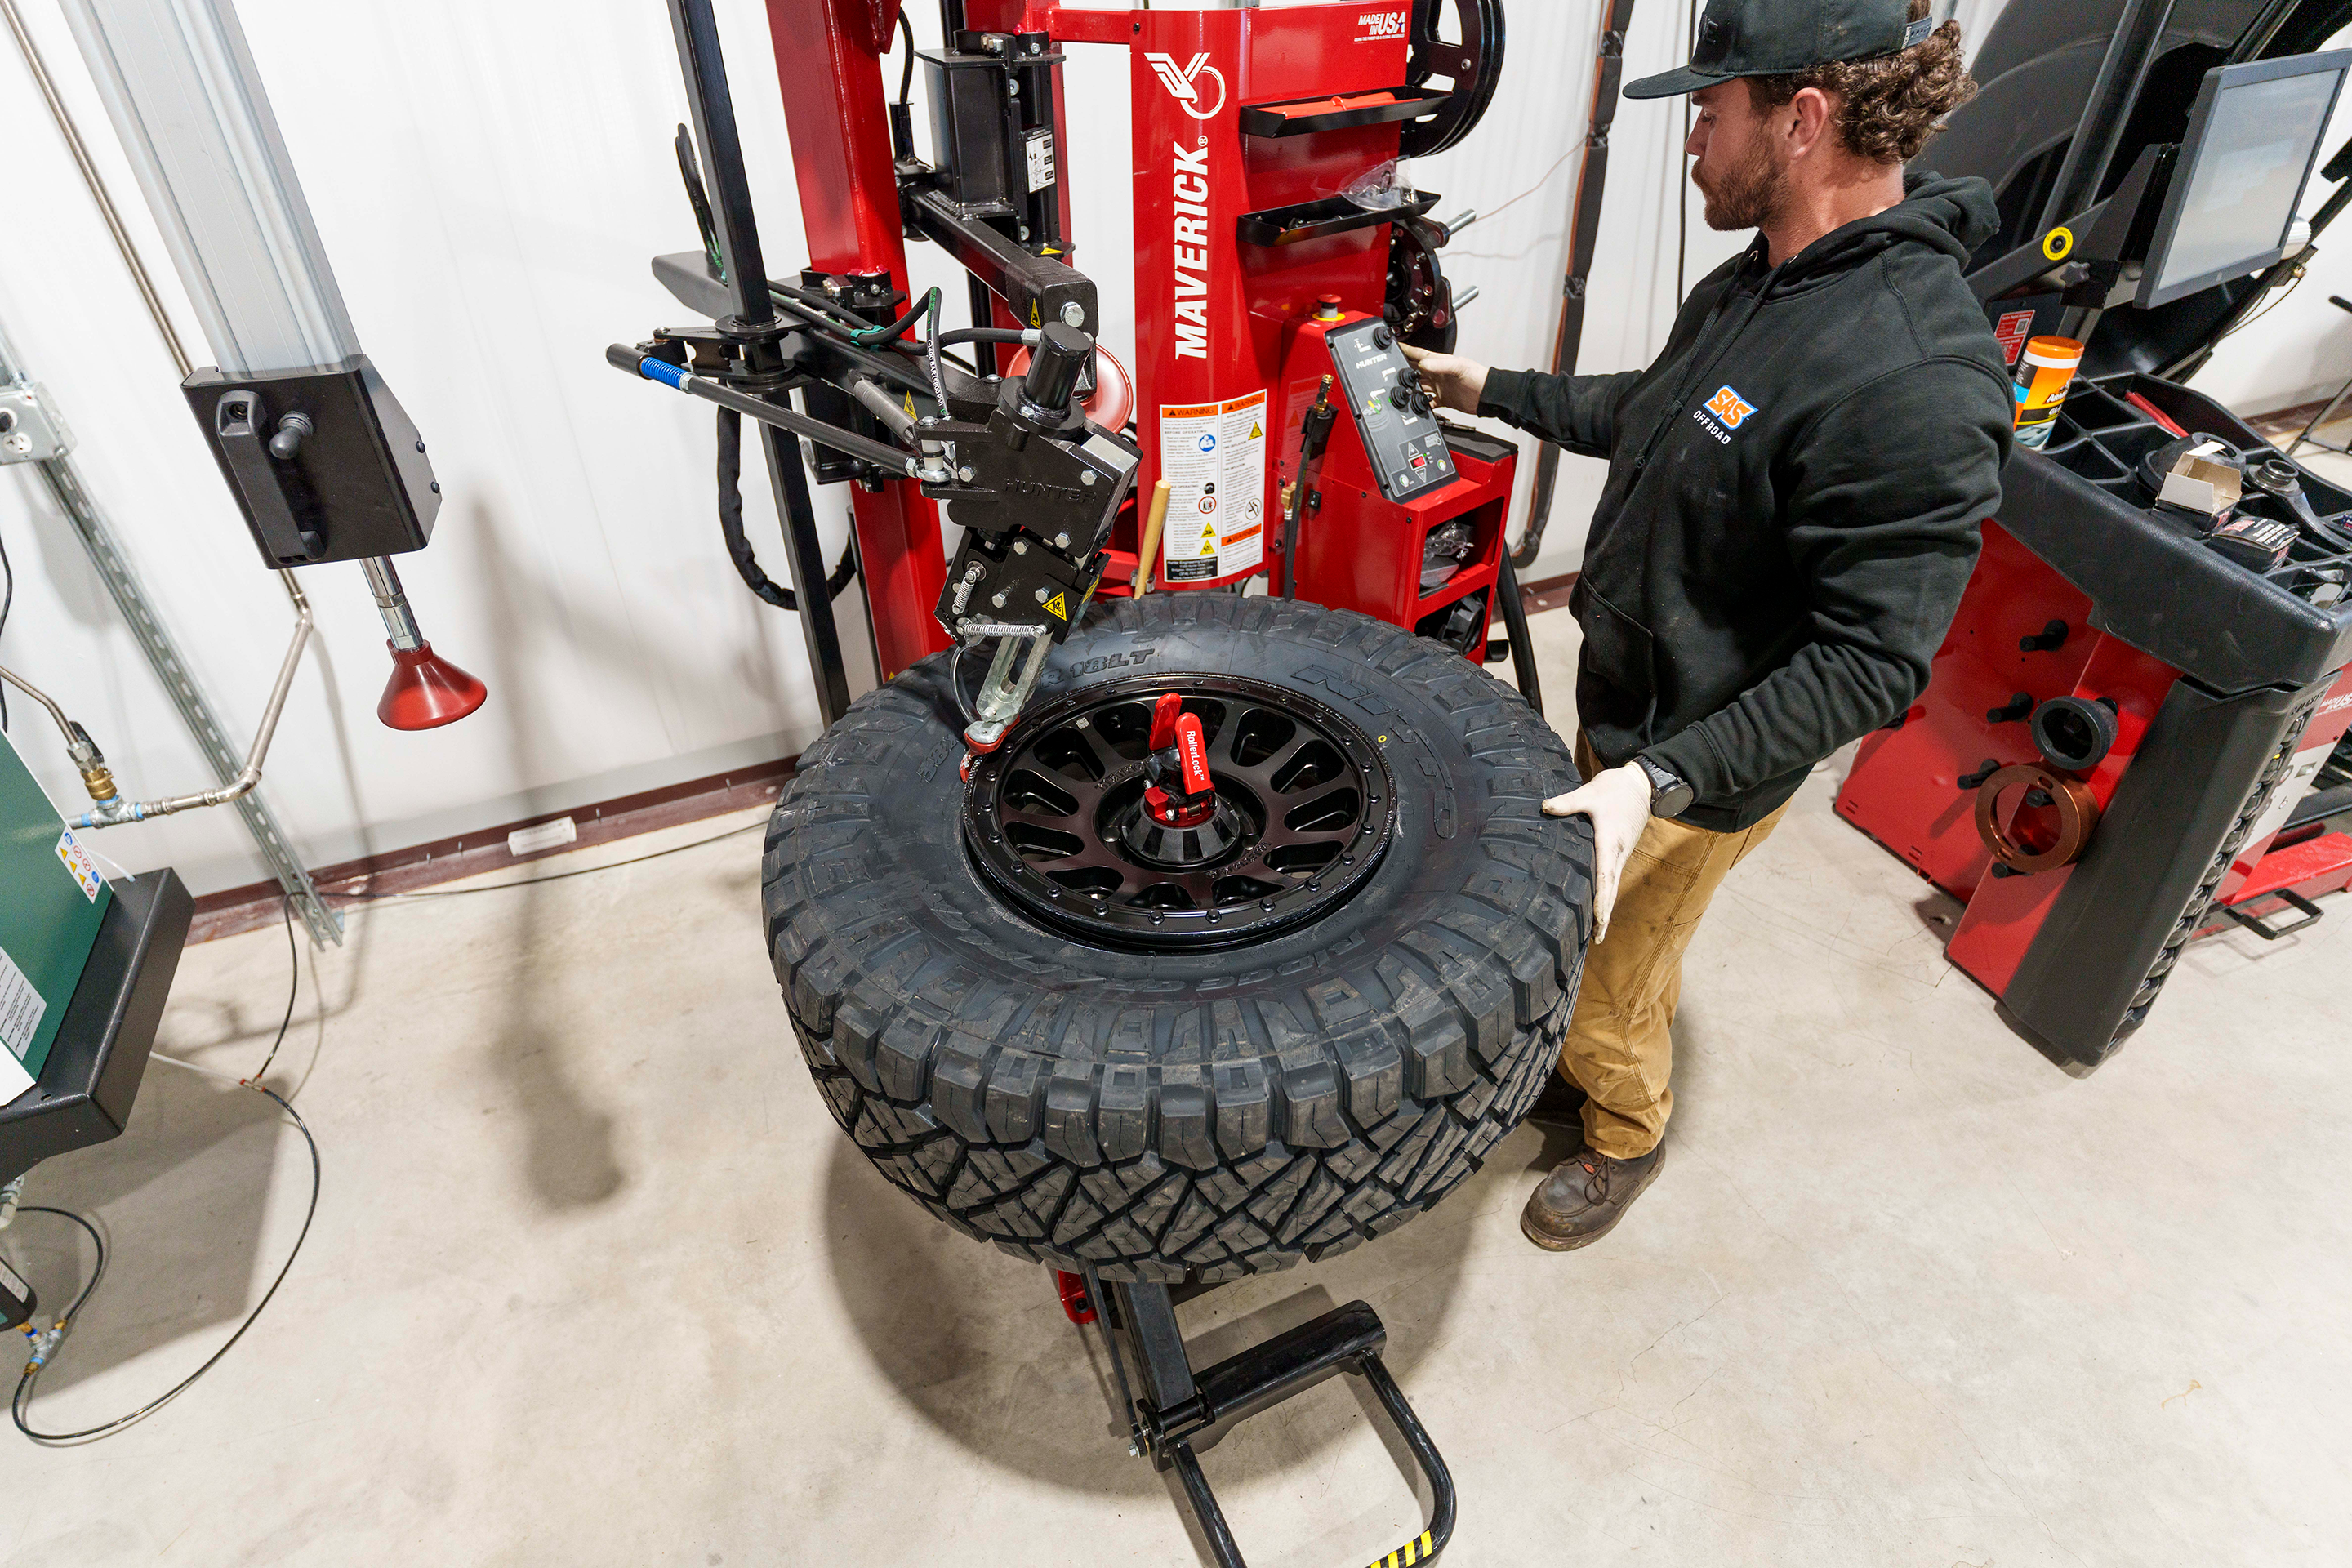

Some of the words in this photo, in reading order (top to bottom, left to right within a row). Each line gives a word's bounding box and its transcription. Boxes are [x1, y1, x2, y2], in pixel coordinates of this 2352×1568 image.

[1358, 14, 1381, 25] MADE
[1377, 11, 1406, 35] USA
[1369, 25, 1379, 35] IN
[1356, 353, 1388, 369] HUNTER
[1234, 394, 1263, 408] WARNING
[1704, 385, 1757, 429] SAS
[1177, 408, 1214, 416] WARNING
[1692, 410, 1731, 444] OFFROAD
[1003, 478, 1098, 504] HUNTER
[1070, 648, 1156, 678] 18LT
